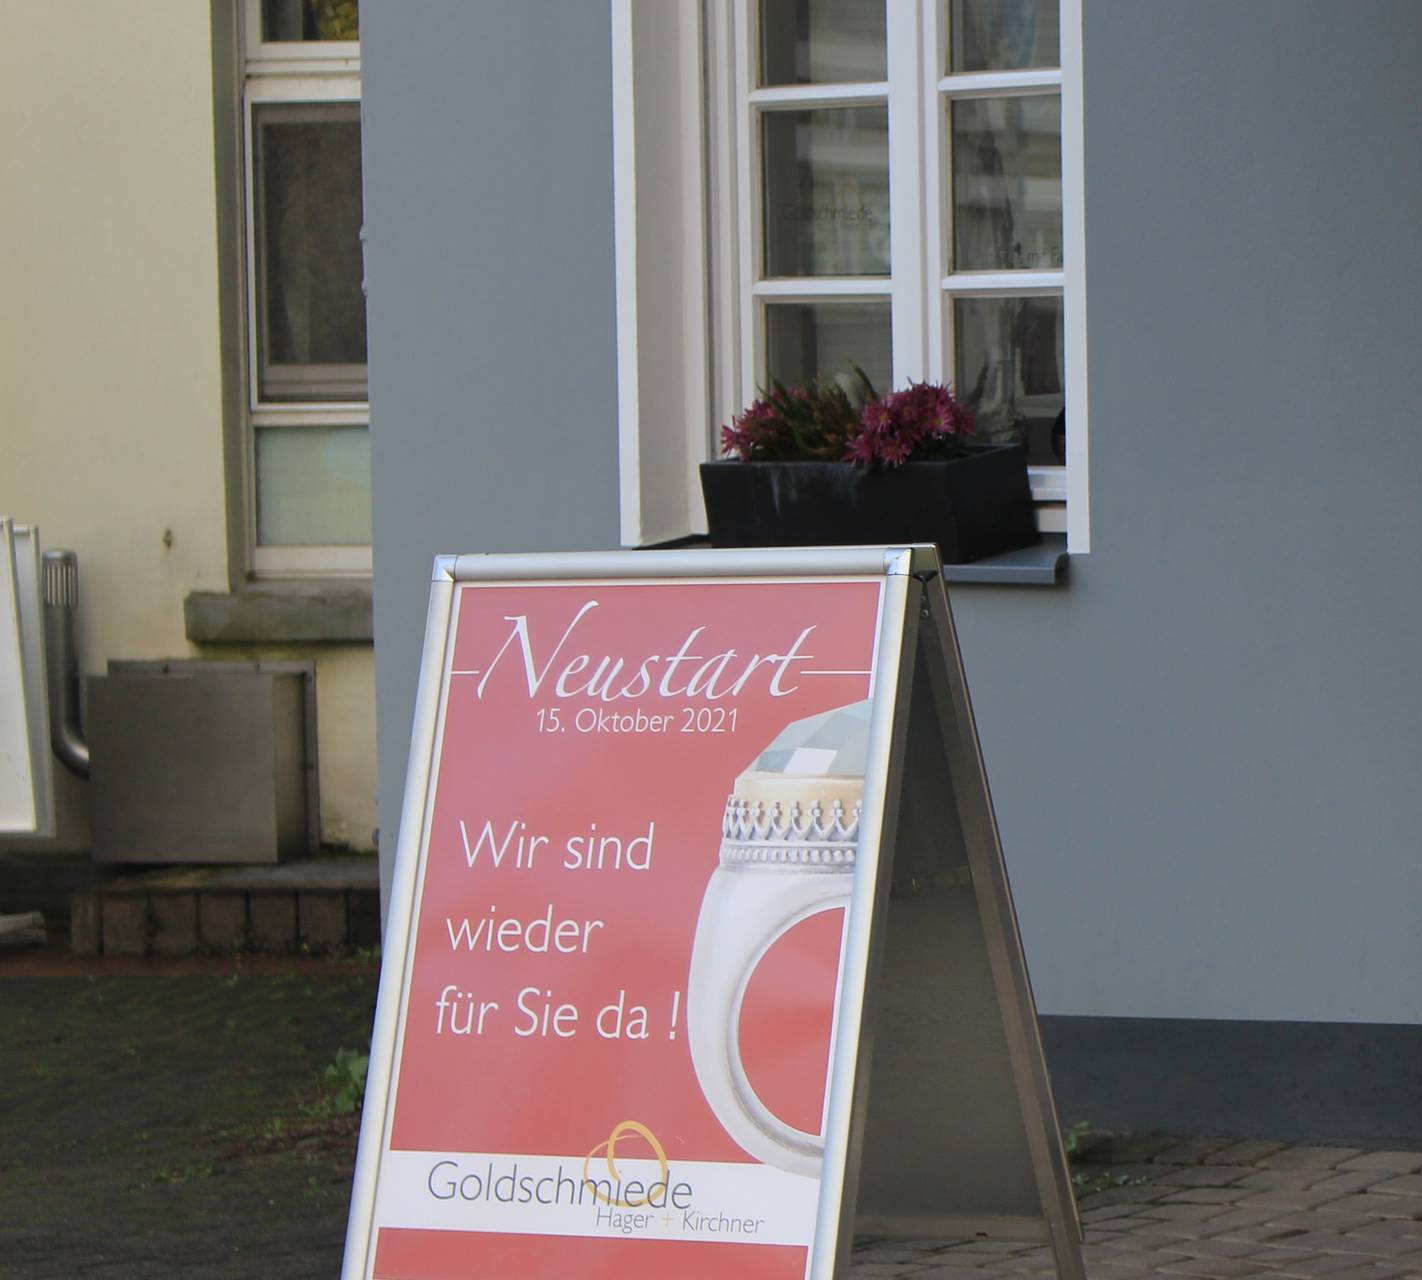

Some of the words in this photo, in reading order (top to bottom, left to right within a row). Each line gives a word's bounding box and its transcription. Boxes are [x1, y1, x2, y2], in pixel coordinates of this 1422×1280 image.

[476, 600, 817, 702] Neustart
[536, 708, 565, 733] 15.
[575, 708, 674, 733] Oktober
[680, 708, 739, 733] 2021
[459, 819, 548, 869] Wir
[564, 821, 655, 871] sind
[446, 904, 604, 954] wieder
[436, 985, 499, 1035] für
[514, 987, 578, 1037] Sie
[596, 990, 650, 1040] da
[427, 1160, 693, 1210] Goldschmiede
[596, 1209, 654, 1235] Hager
[682, 1210, 765, 1235] Kirchner
